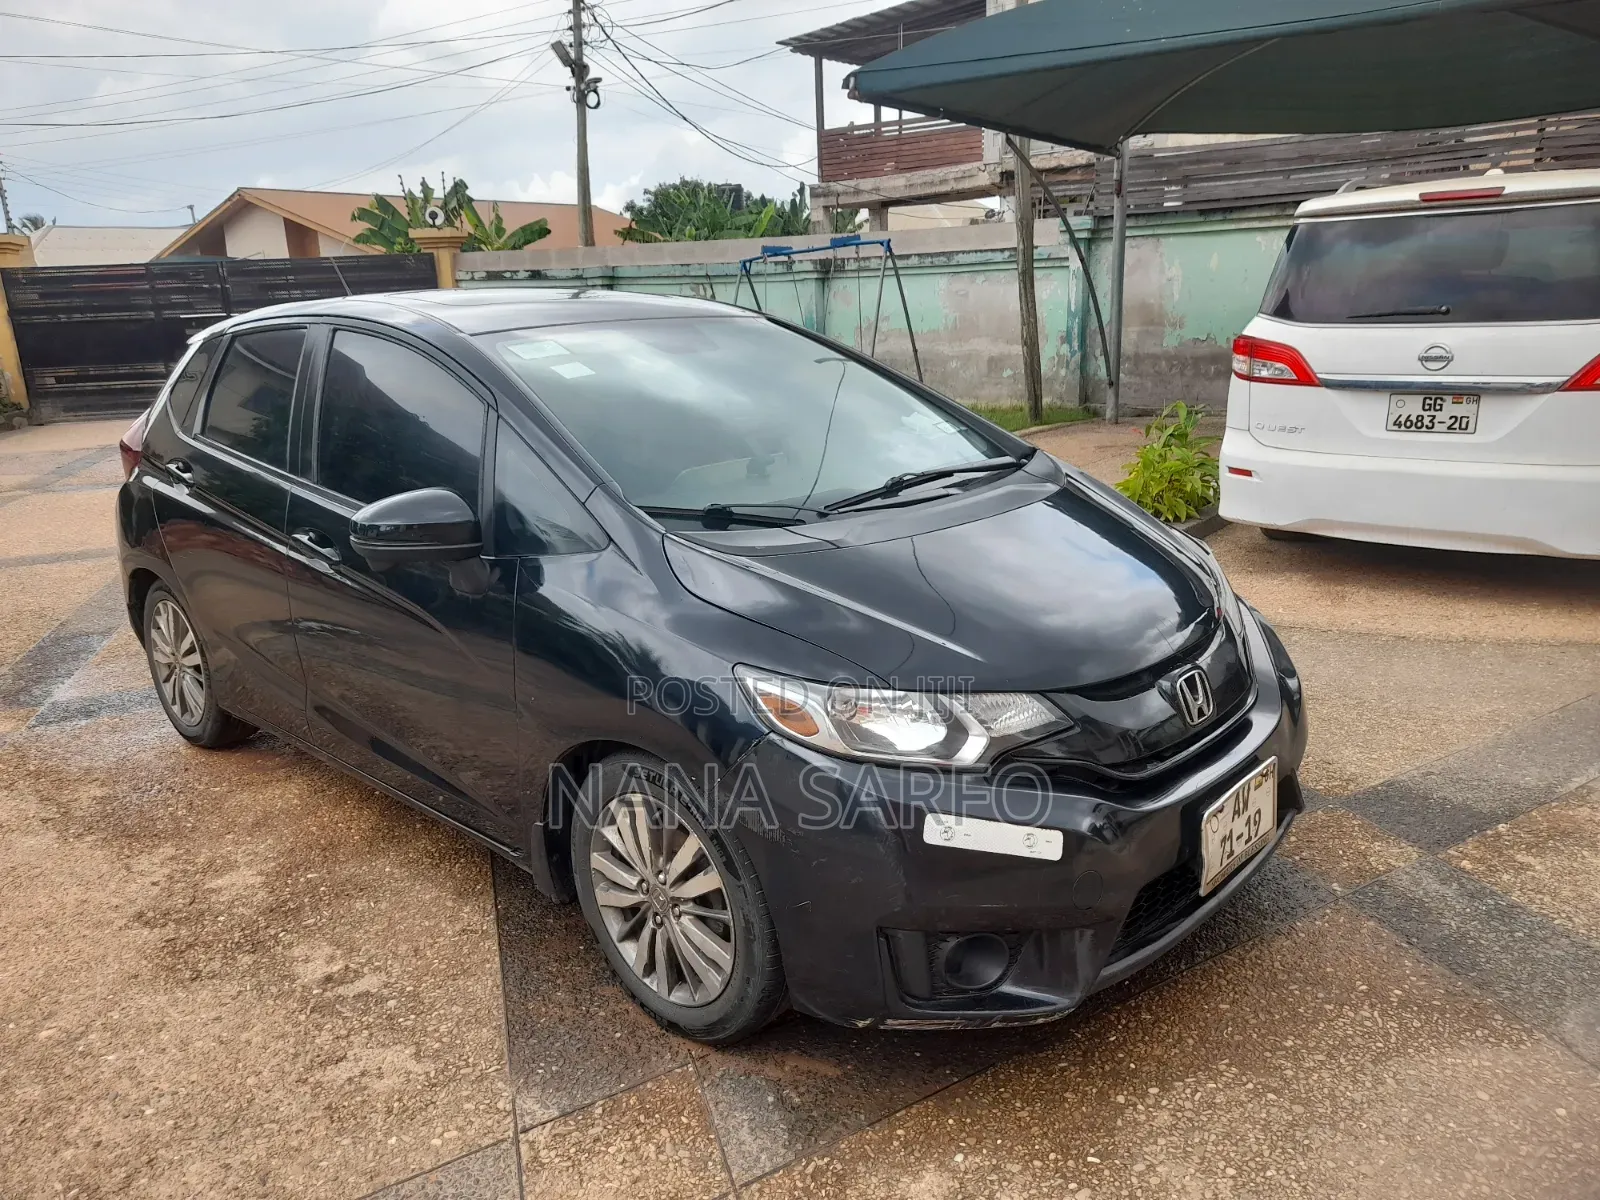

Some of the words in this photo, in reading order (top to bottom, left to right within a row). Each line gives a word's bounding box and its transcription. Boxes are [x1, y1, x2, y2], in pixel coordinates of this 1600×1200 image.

[1422, 396, 1444, 412] GG
[1465, 397, 1478, 405] GH
[1255, 422, 1306, 434] QUEST
[1393, 414, 1470, 431] 4683-20
[1231, 782, 1251, 823] AW
[1219, 807, 1262, 867] 71-19
